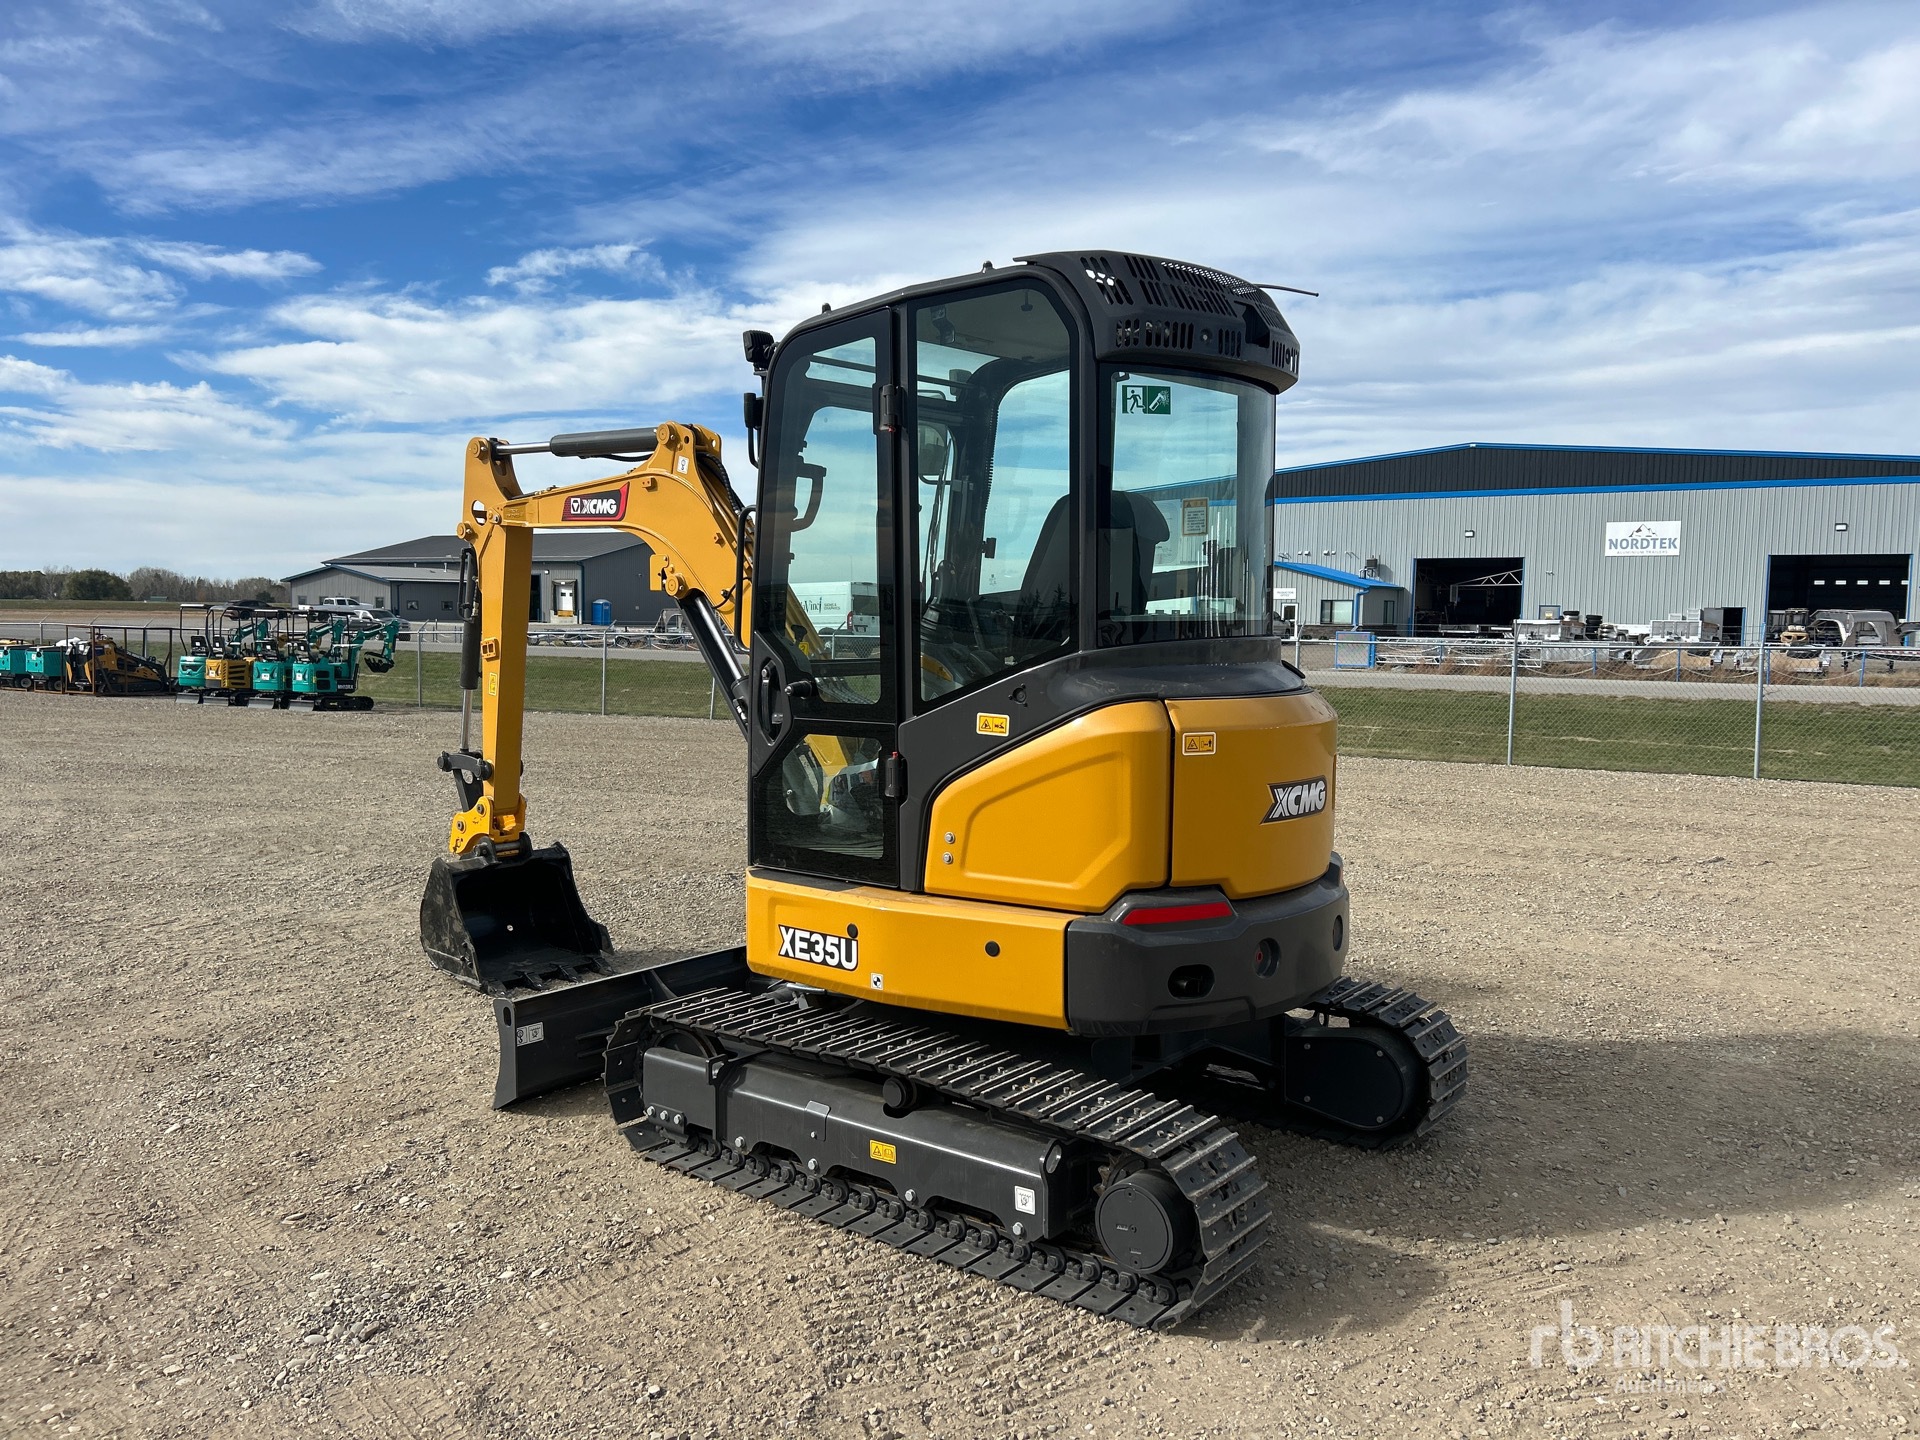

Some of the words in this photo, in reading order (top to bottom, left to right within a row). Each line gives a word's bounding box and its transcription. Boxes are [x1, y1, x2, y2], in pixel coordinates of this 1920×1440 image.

[581, 498, 617, 515] XCMG
[1608, 538, 1678, 550] NORDTEK
[1268, 780, 1326, 819] XCMG
[780, 926, 858, 970] XE35U
